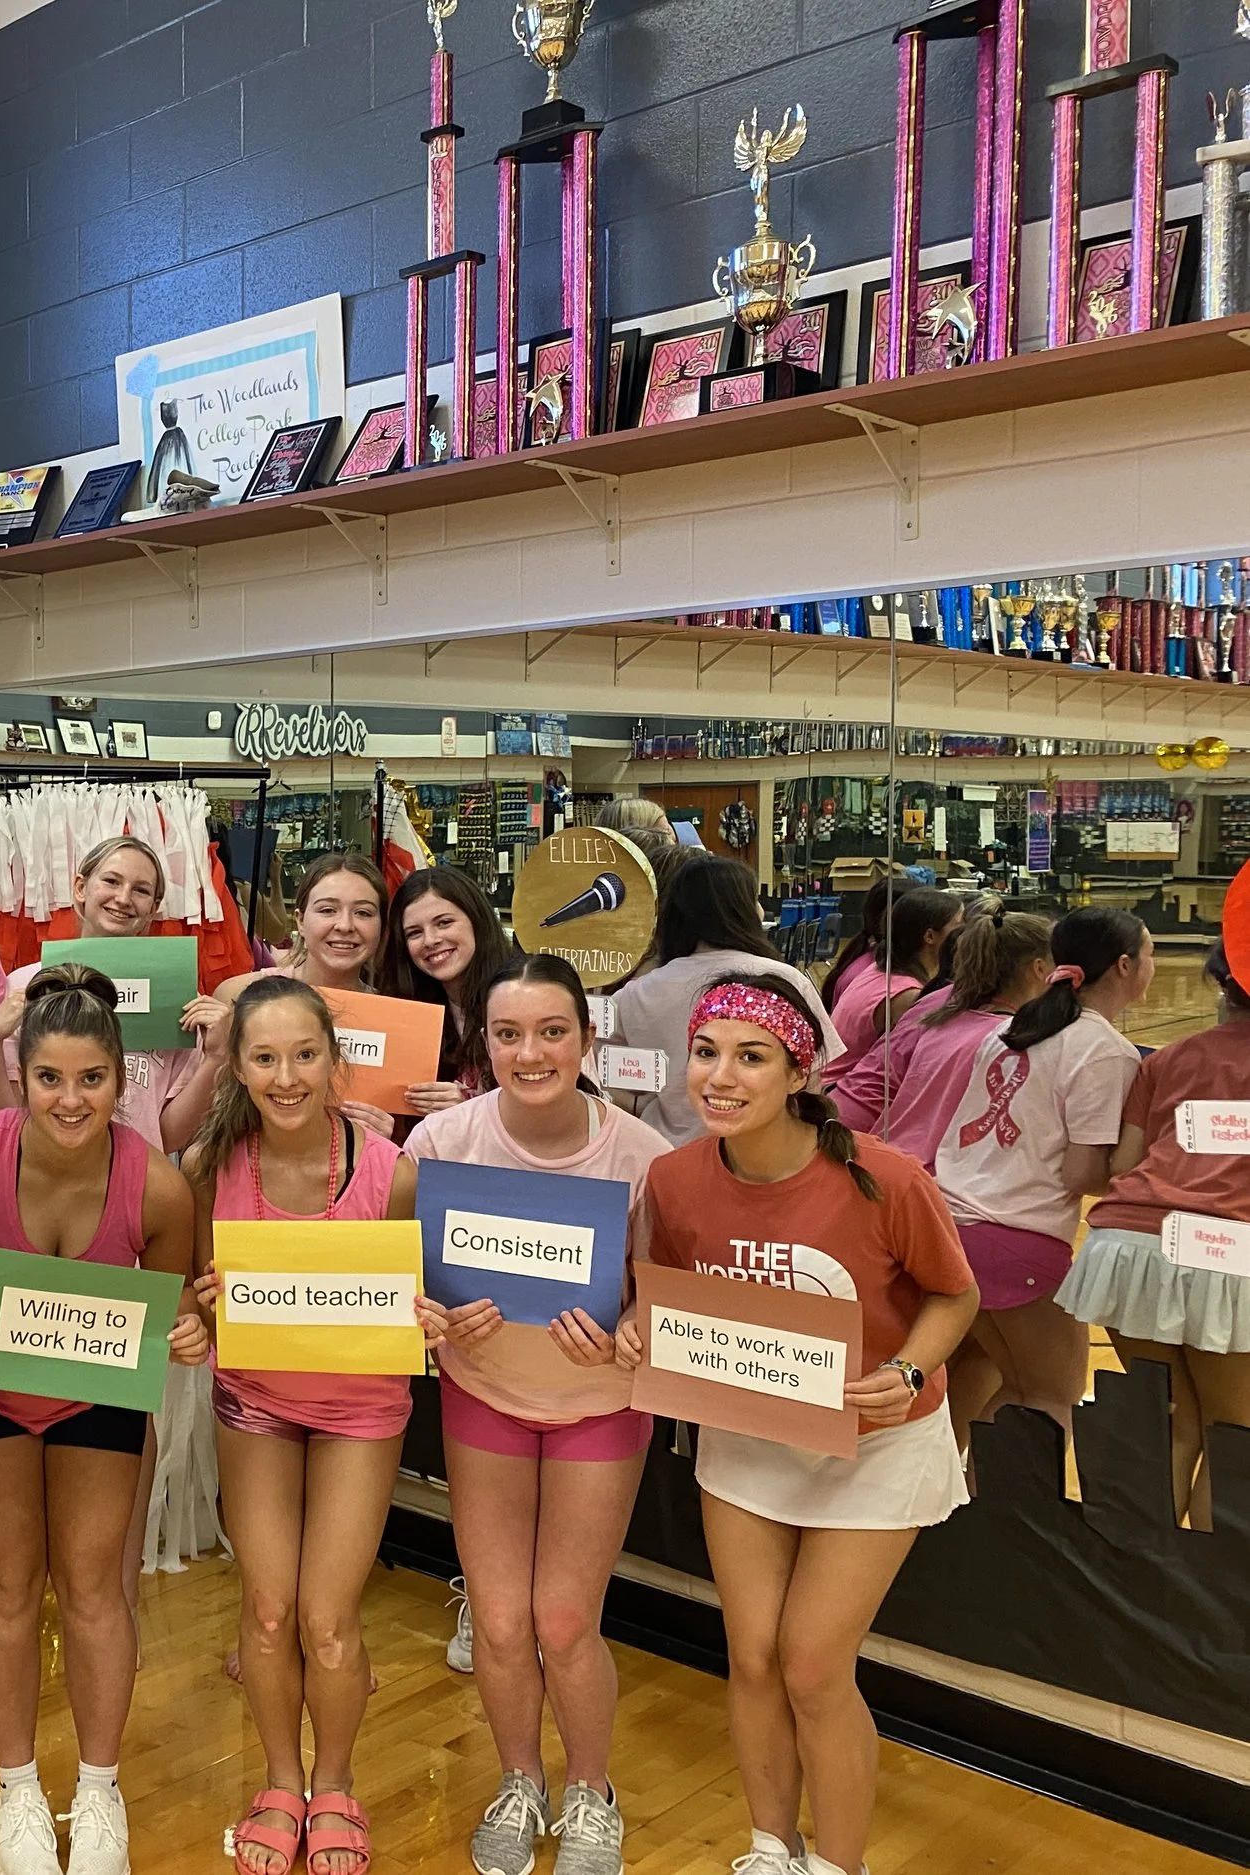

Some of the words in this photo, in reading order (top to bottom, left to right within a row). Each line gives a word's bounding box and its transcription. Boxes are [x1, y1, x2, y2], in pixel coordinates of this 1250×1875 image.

[187, 393, 216, 423] The
[217, 370, 299, 414] Woodlands
[197, 423, 247, 451] College
[246, 407, 292, 443] Park
[212, 450, 261, 482] Reveli
[550, 837, 617, 864] ELLIE'S
[539, 946, 632, 973] ERTAINERS
[117, 987, 138, 1003] air
[338, 1036, 378, 1057] Firm
[450, 1227, 582, 1266] Consistent
[729, 1239, 790, 1271] THE
[231, 1283, 297, 1306] Good
[305, 1286, 399, 1307] teacher
[19, 1298, 96, 1329] Willing
[105, 1307, 127, 1328] to
[10, 1327, 64, 1351] work
[74, 1335, 127, 1358] hard
[658, 1317, 703, 1340] Able
[710, 1327, 729, 1346] to
[736, 1335, 786, 1358] work
[792, 1347, 834, 1369] well
[688, 1350, 727, 1371] with
[735, 1360, 800, 1387] others
